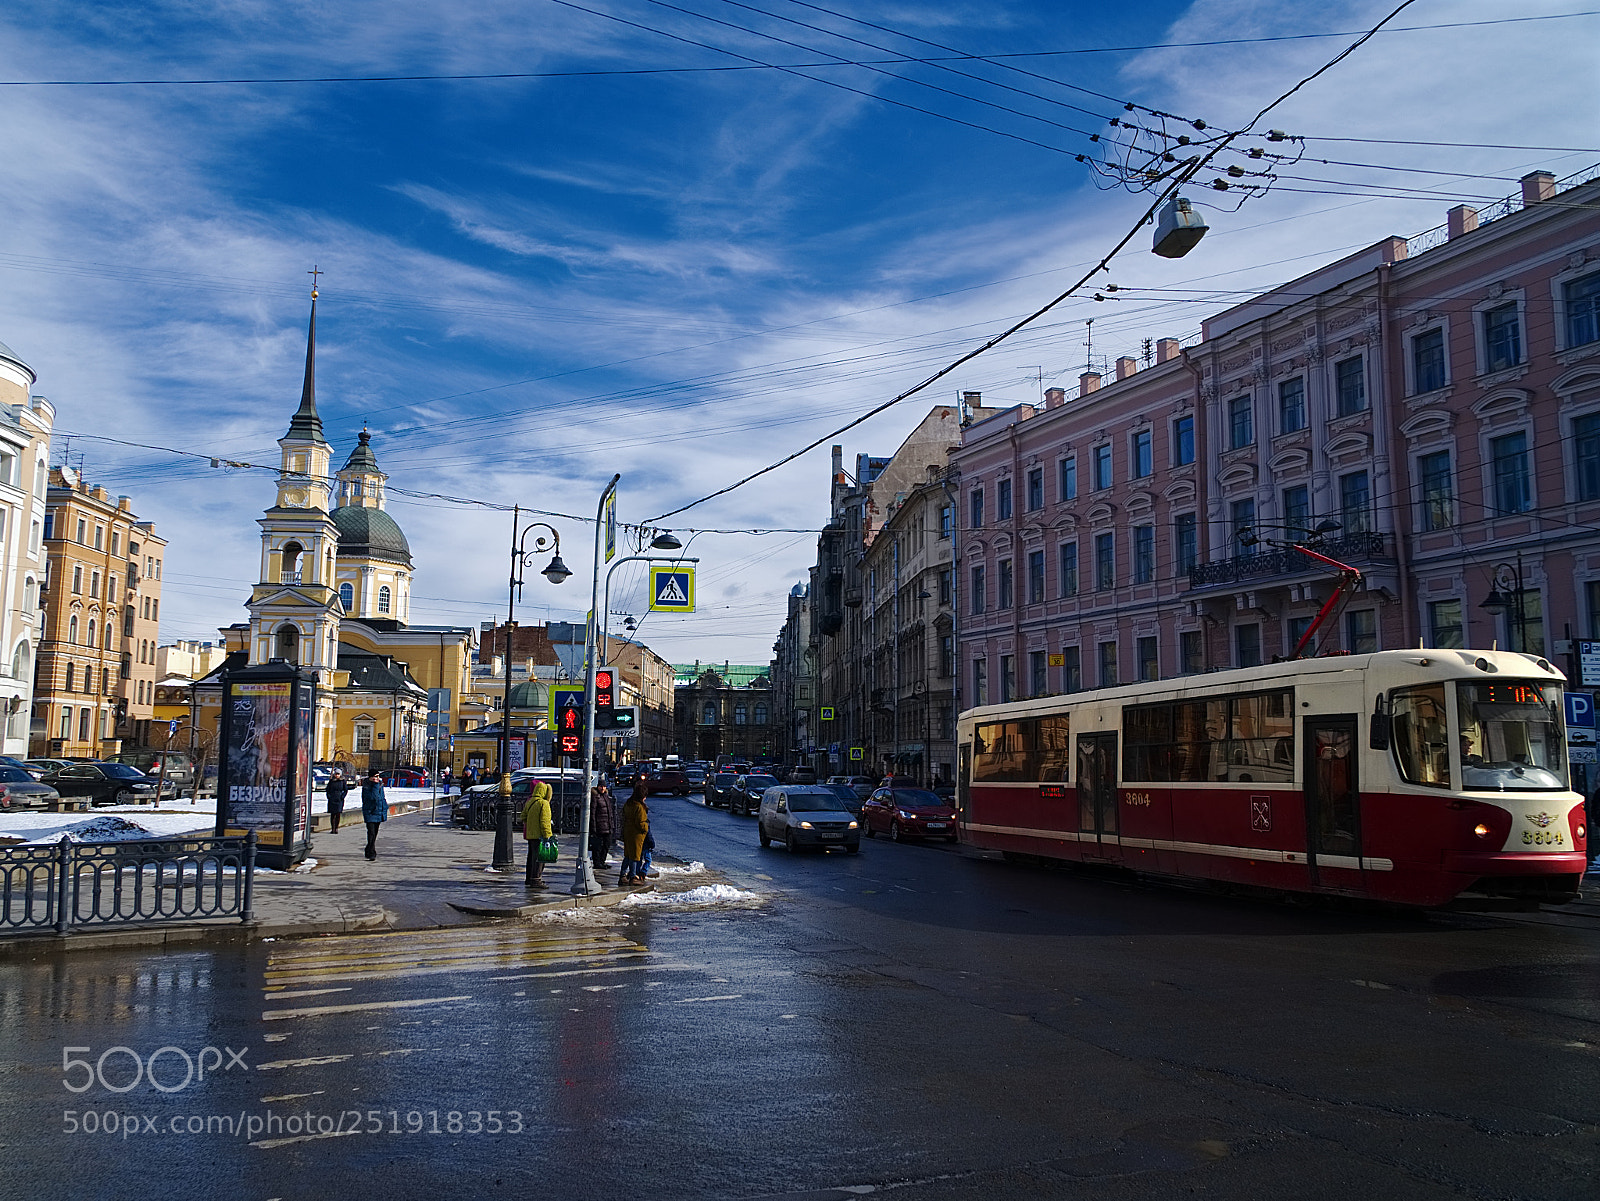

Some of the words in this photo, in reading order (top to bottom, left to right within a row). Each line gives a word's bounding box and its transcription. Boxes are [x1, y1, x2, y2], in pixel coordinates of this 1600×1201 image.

[1583, 643, 1590, 653] P
[598, 694, 611, 705] 52
[1571, 696, 1588, 723] P
[1125, 792, 1151, 807] 3604
[1521, 829, 1564, 846] 3604
